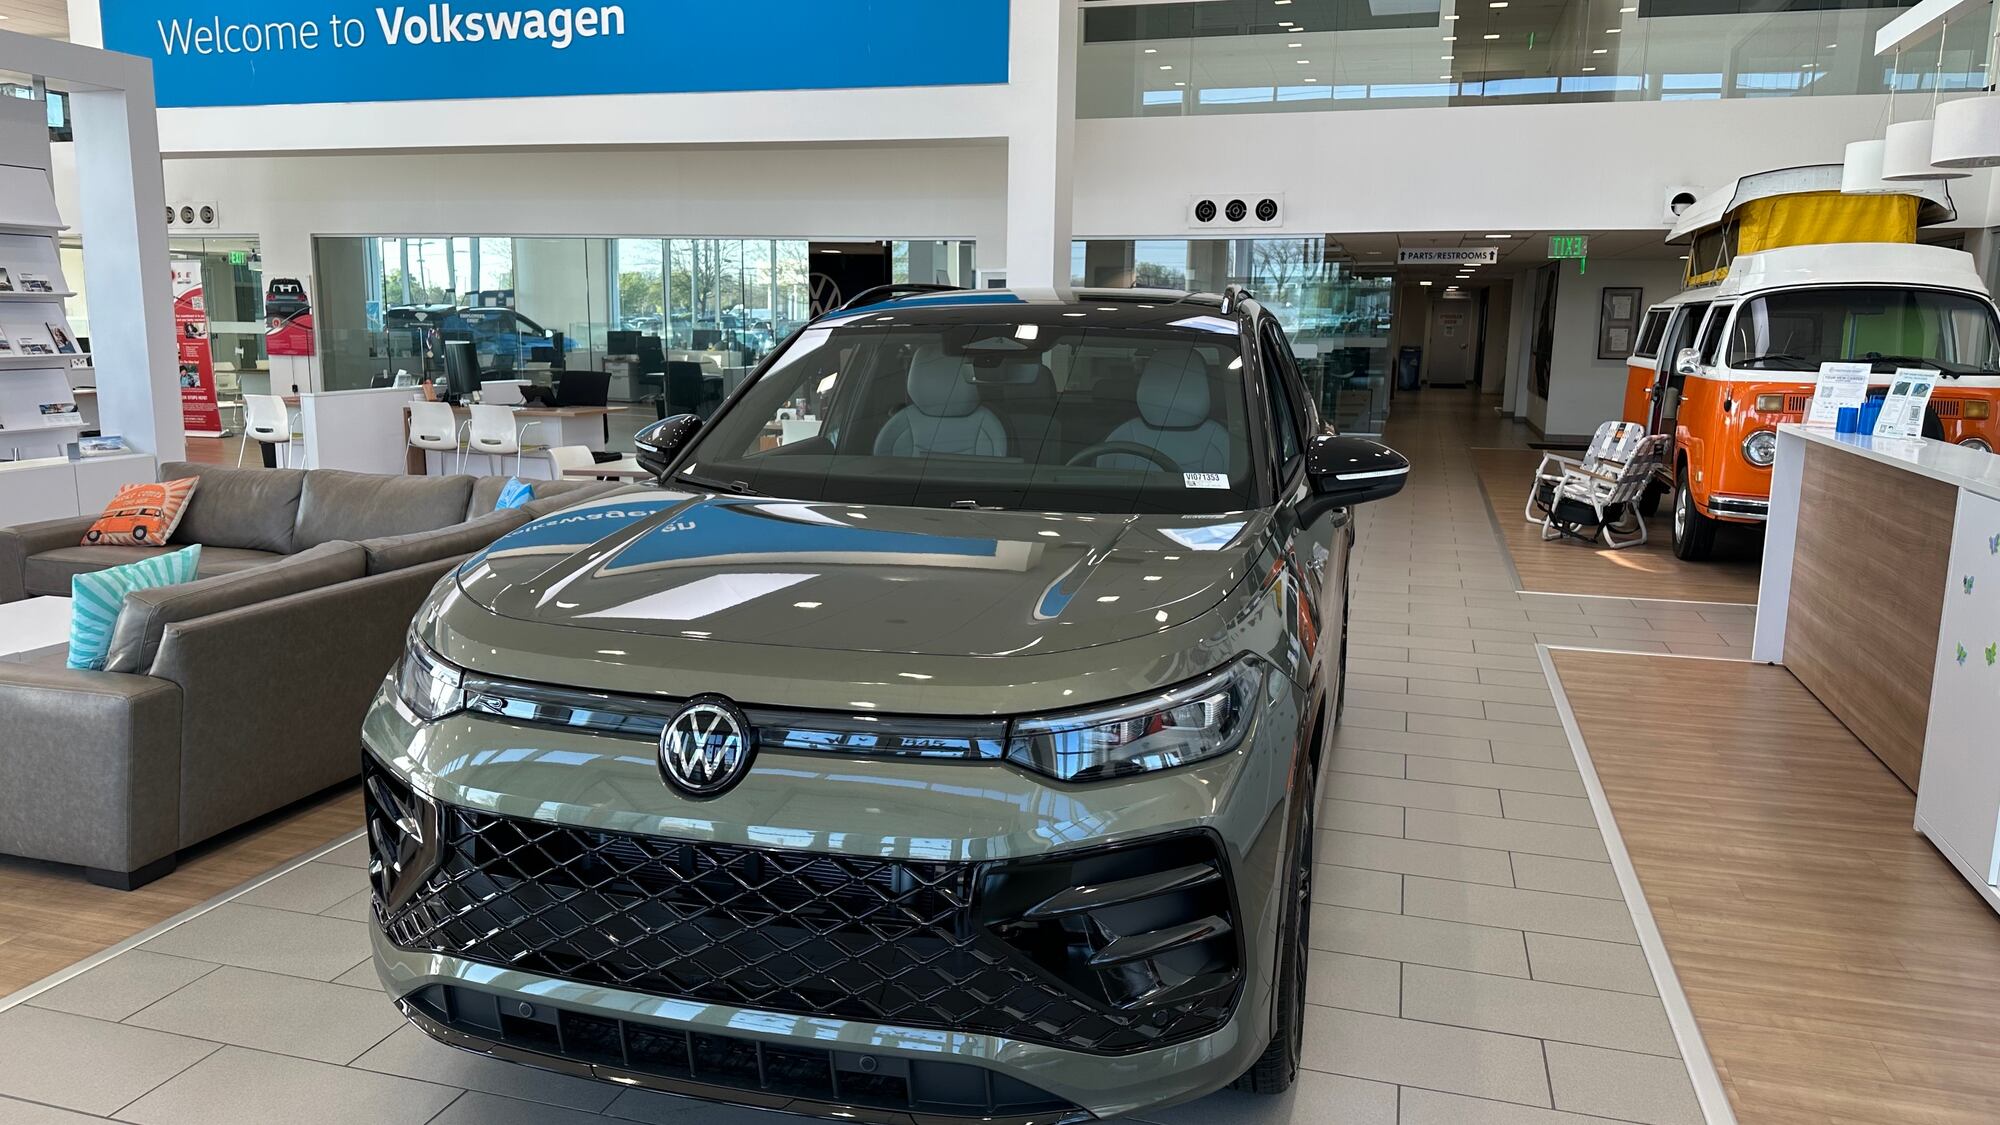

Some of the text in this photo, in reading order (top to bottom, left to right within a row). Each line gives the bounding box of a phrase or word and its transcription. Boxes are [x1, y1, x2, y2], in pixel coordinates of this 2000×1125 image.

[157, 3, 625, 56] Welcome to Volkswagen
[231, 251, 245, 264] EXIT
[1407, 251, 1487, 260] PARTS/RESTROOMS
